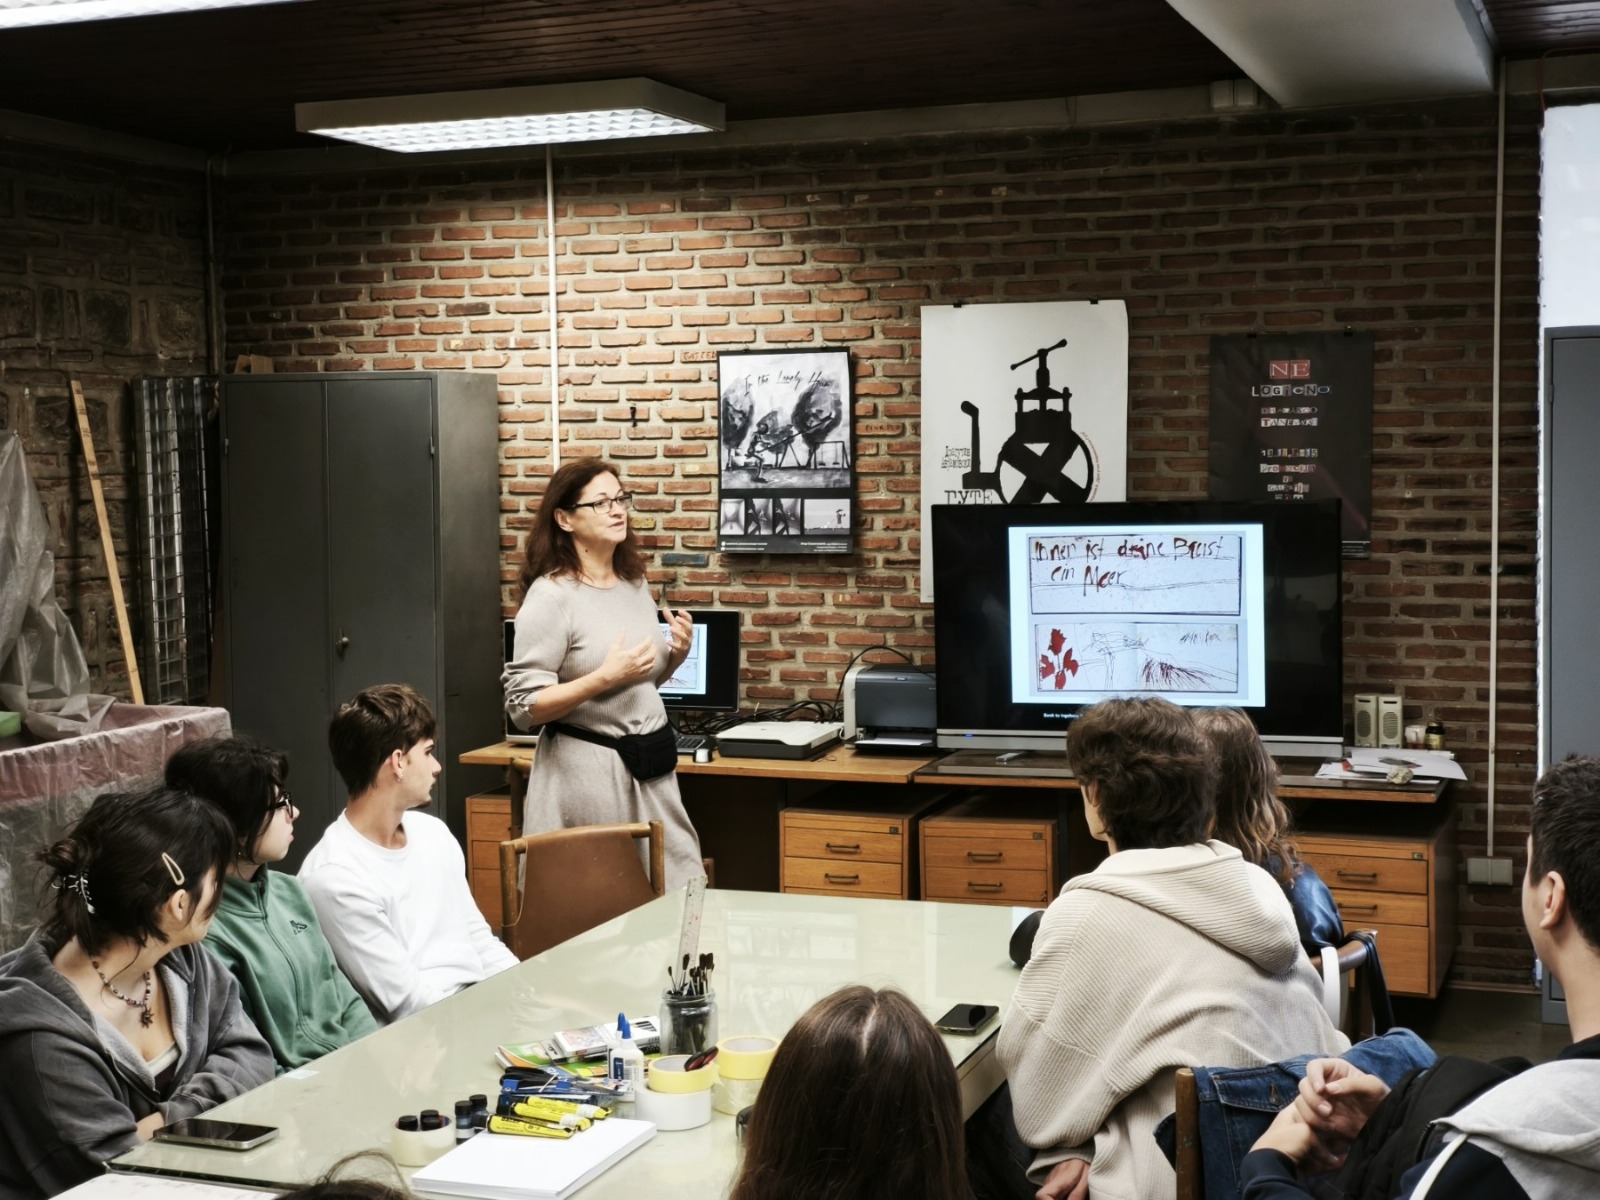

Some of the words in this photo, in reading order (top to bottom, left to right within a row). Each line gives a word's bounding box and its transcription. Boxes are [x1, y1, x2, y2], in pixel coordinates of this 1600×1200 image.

[757, 373, 770, 387] the
[776, 370, 803, 391] Lonely
[1270, 361, 1311, 378] NE
[1086, 538, 1104, 562] ist
[1051, 563, 1075, 581] ein
[1084, 565, 1127, 596] Meer
